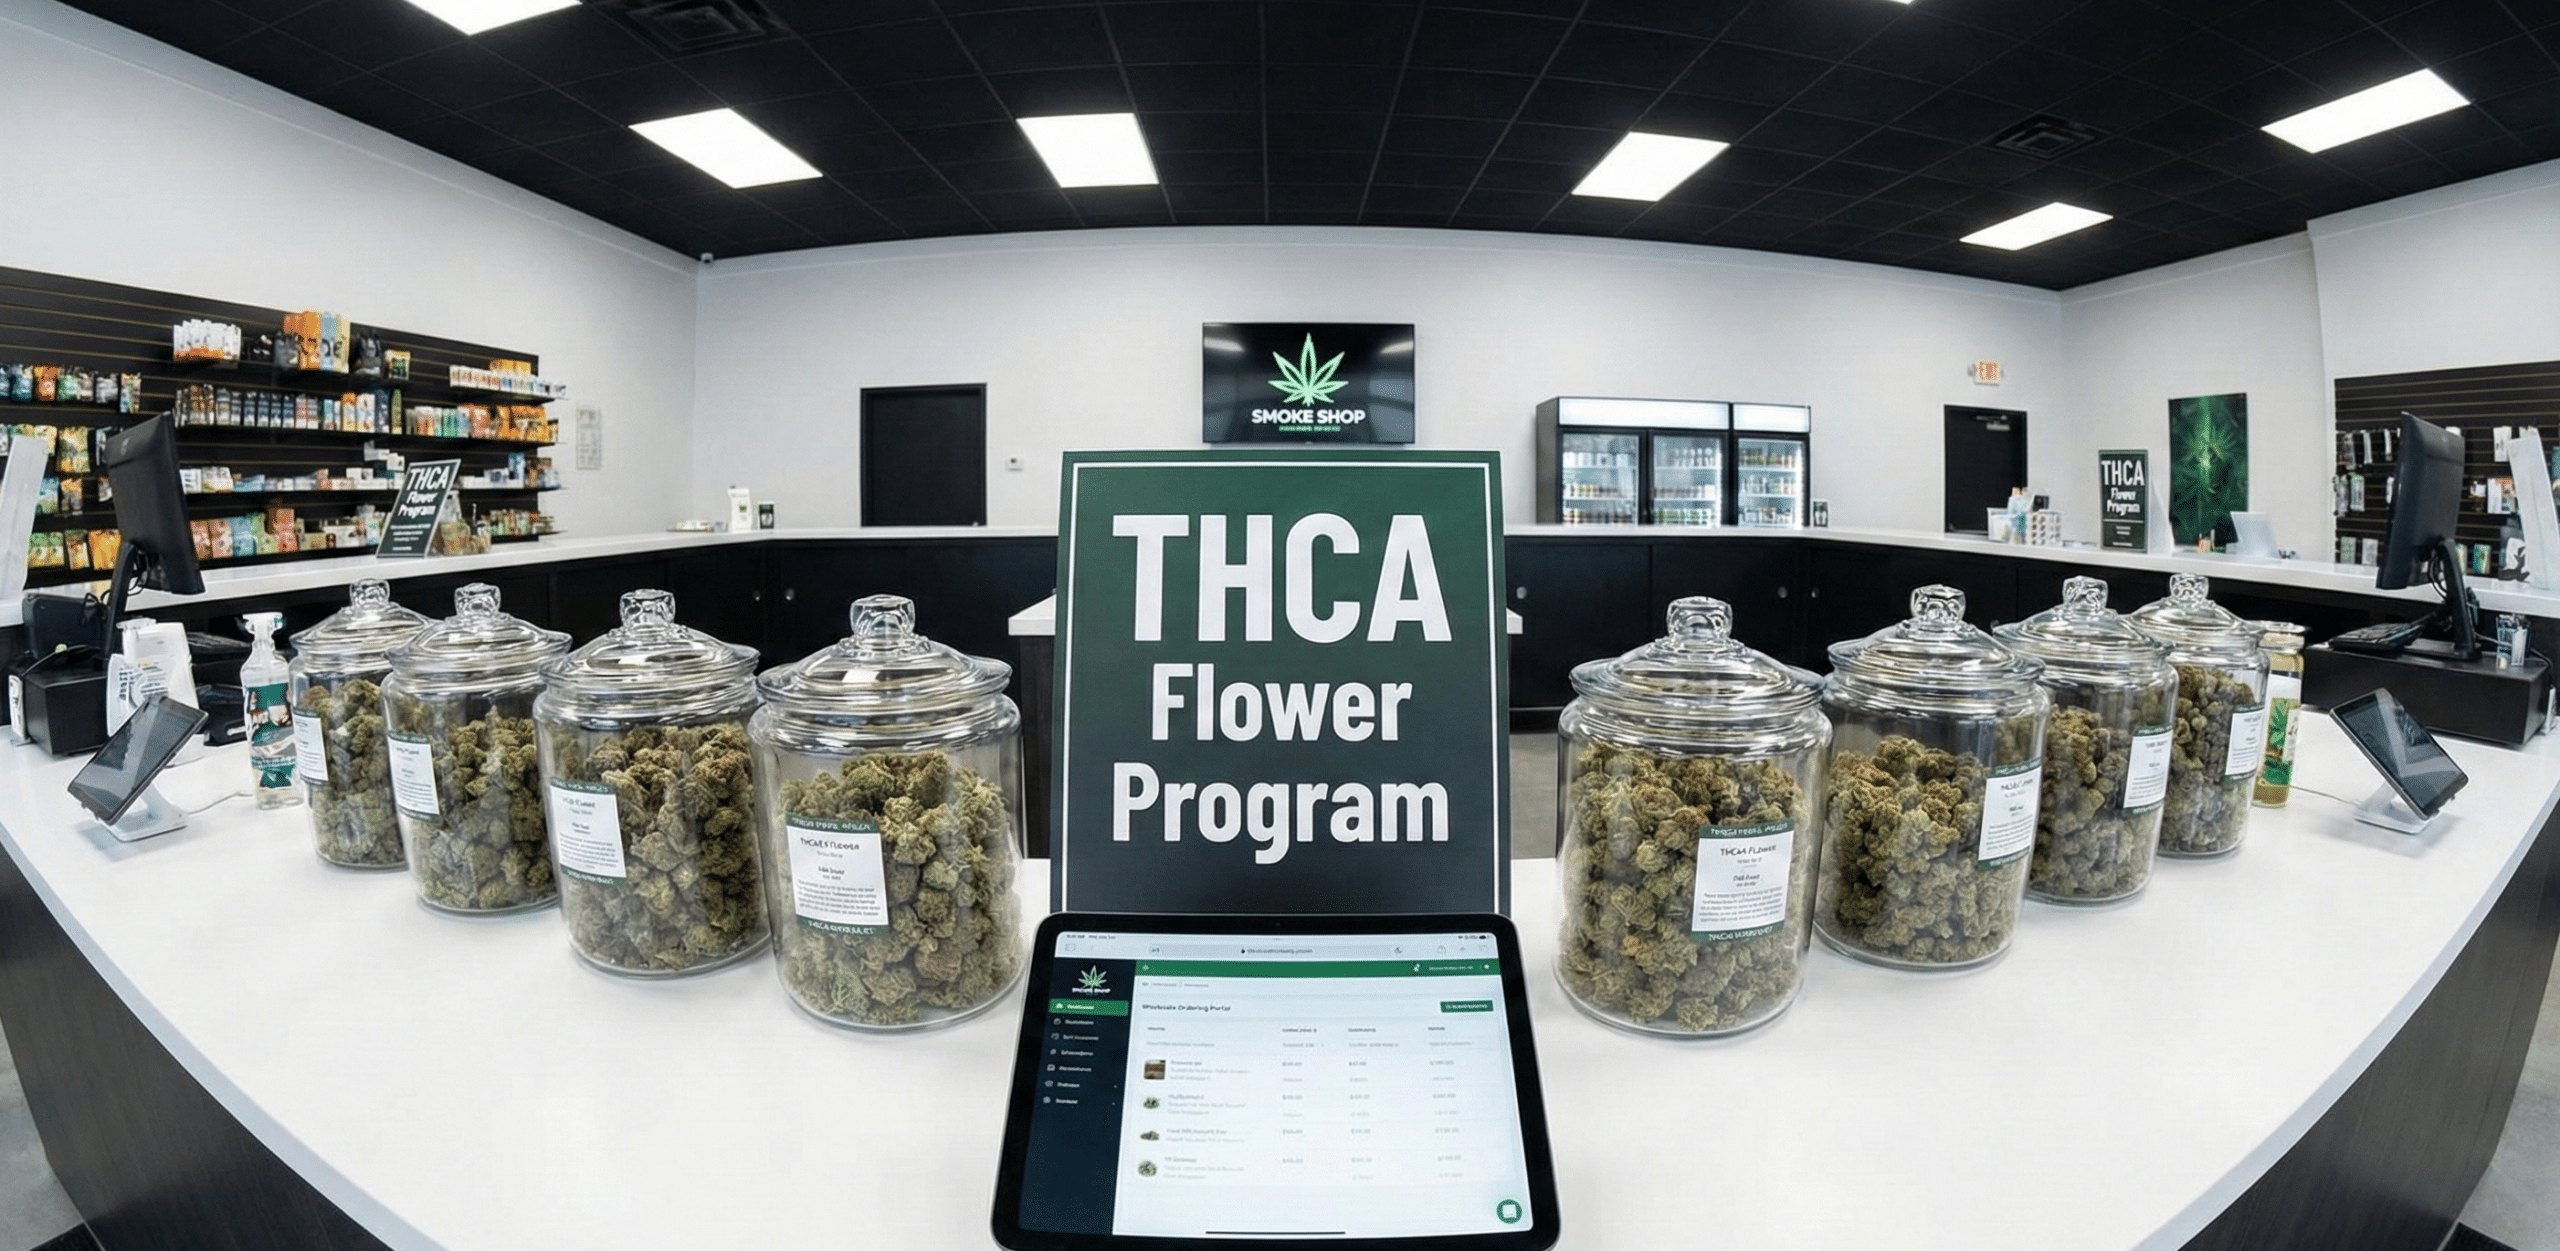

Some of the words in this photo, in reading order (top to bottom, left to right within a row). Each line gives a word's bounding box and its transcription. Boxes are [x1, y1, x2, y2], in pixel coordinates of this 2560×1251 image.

[1251, 409, 1314, 424] SMOKE
[1317, 409, 1366, 424] SHOP
[406, 466, 451, 491] THCA
[2101, 460, 2145, 486] THCA
[1112, 512, 1452, 643] THCA
[1152, 663, 1413, 742] Flower
[1112, 762, 1449, 864] Program
